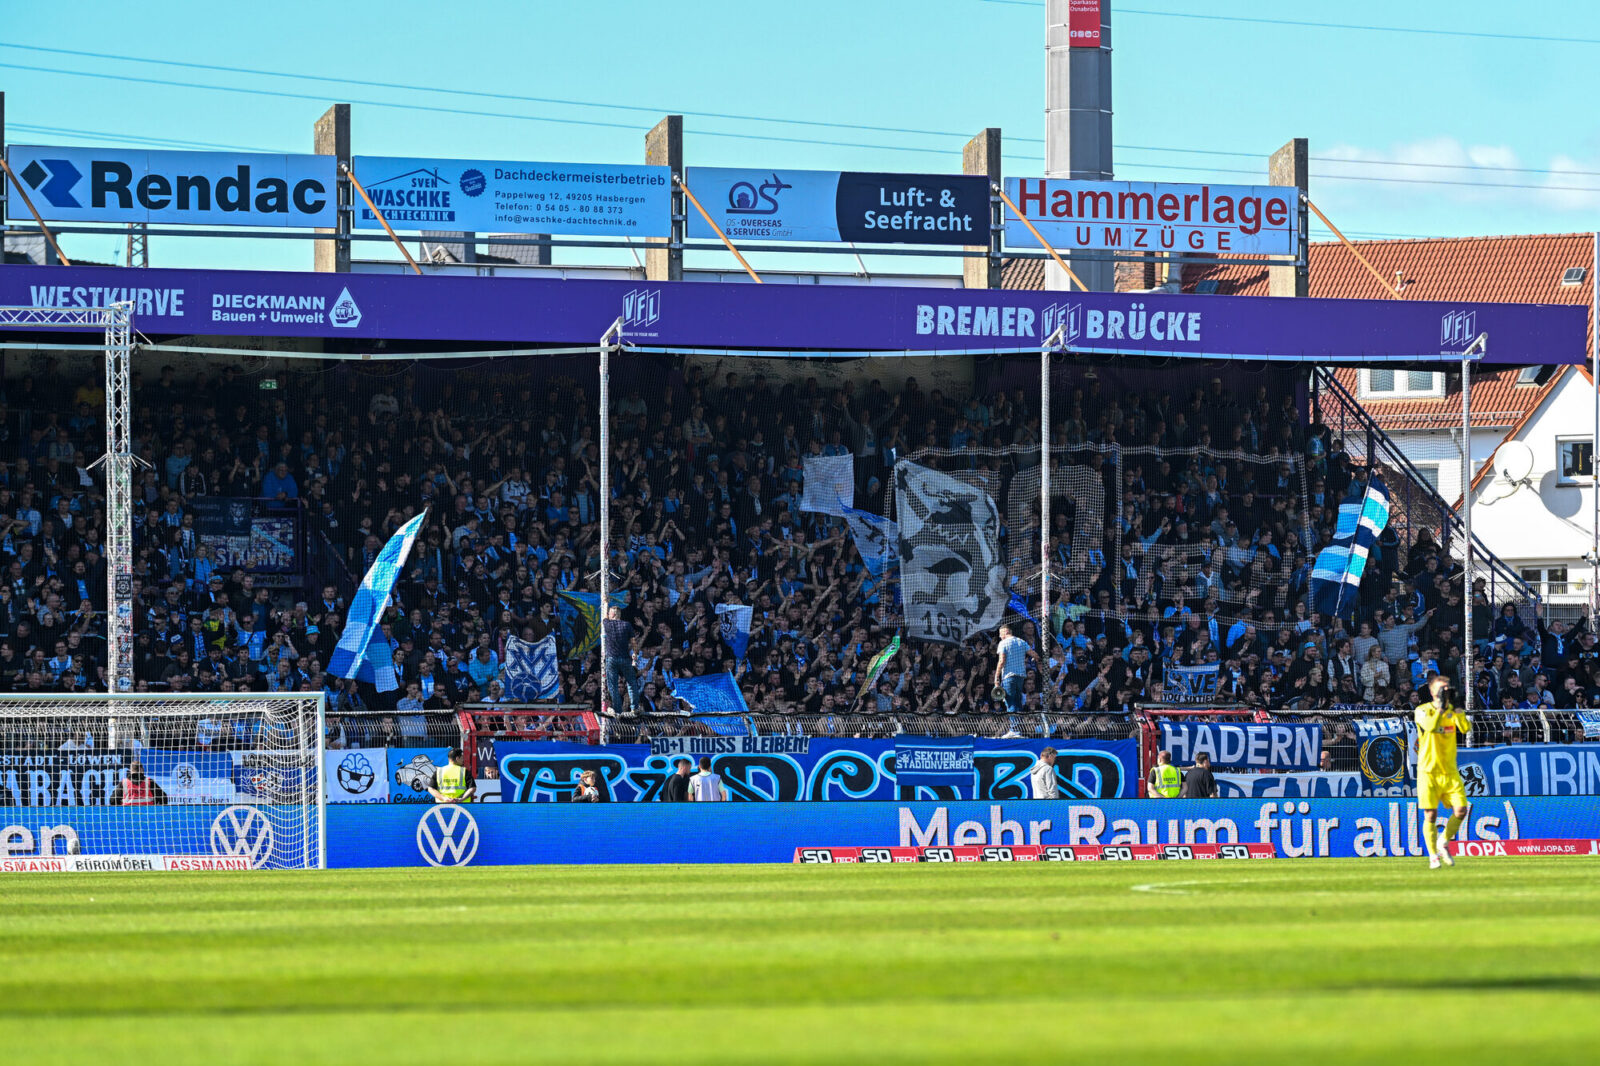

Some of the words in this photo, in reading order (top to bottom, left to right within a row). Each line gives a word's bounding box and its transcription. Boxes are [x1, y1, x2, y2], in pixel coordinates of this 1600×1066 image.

[411, 177, 438, 188] SVEN
[494, 168, 666, 186] Dachdeckermeisterbetrieb
[91, 160, 326, 214] Rendac
[366, 189, 450, 208] WASCHKE
[494, 190, 545, 201] Pappelweg
[565, 193, 593, 202] 49205
[596, 194, 646, 204] Hasbergen
[880, 187, 933, 207] Luft-
[939, 189, 956, 208] &
[495, 202, 533, 211] Telefon:
[536, 203, 542, 211] 0
[545, 203, 556, 212] 54
[558, 204, 570, 212] 05
[579, 205, 590, 213] 80
[593, 205, 604, 213] 88
[607, 205, 623, 214] 373
[1019, 178, 1288, 235] Hammerlage
[494, 214, 637, 227] info@waschke-dachtechnik.de
[741, 218, 782, 228] OVERSEAS
[864, 210, 973, 232] Seefracht
[726, 228, 732, 236] &
[733, 228, 771, 236] SERVICES
[772, 229, 793, 237] GmbH
[1076, 225, 1232, 251] UMZÜGE
[30, 285, 185, 317] WESTKURVE
[212, 293, 326, 310] DIECKMANN
[624, 293, 658, 323] VFL
[212, 309, 256, 322] Bauen
[259, 312, 267, 322] +
[270, 310, 325, 324] Umwelt
[916, 304, 1036, 337] BREMER
[1086, 303, 1202, 342] BRÜCKE
[1443, 314, 1473, 342] VFL
[1353, 717, 1404, 737] MIB
[651, 737, 684, 755] 50+1
[690, 736, 736, 754] MUSS
[742, 736, 809, 754] BLEIBEN!
[1162, 723, 1319, 767] HADERN
[0, 755, 57, 766] STADT
[68, 754, 122, 765] LÖWEN
[914, 750, 956, 761] SEKTION
[896, 759, 974, 769] STADIONVERBOT
[899, 804, 1052, 846] Mehr
[1068, 805, 1239, 846] Raum
[1254, 801, 1340, 857] für
[802, 850, 831, 862] SO
[862, 849, 891, 862] SO
[924, 849, 953, 862] SO
[984, 848, 1013, 861] SO
[1047, 848, 1073, 861] SO
[1104, 847, 1131, 860] SO
[1165, 847, 1193, 860] SO
[1222, 846, 1249, 859] SO
[1456, 842, 1507, 856] JOPA
[1517, 845, 1576, 853] WWW.JOPA.DE
[0, 860, 62, 872] SMANN
[75, 857, 153, 871] BÜROMÖBEL
[170, 859, 249, 872] ASSMANN
